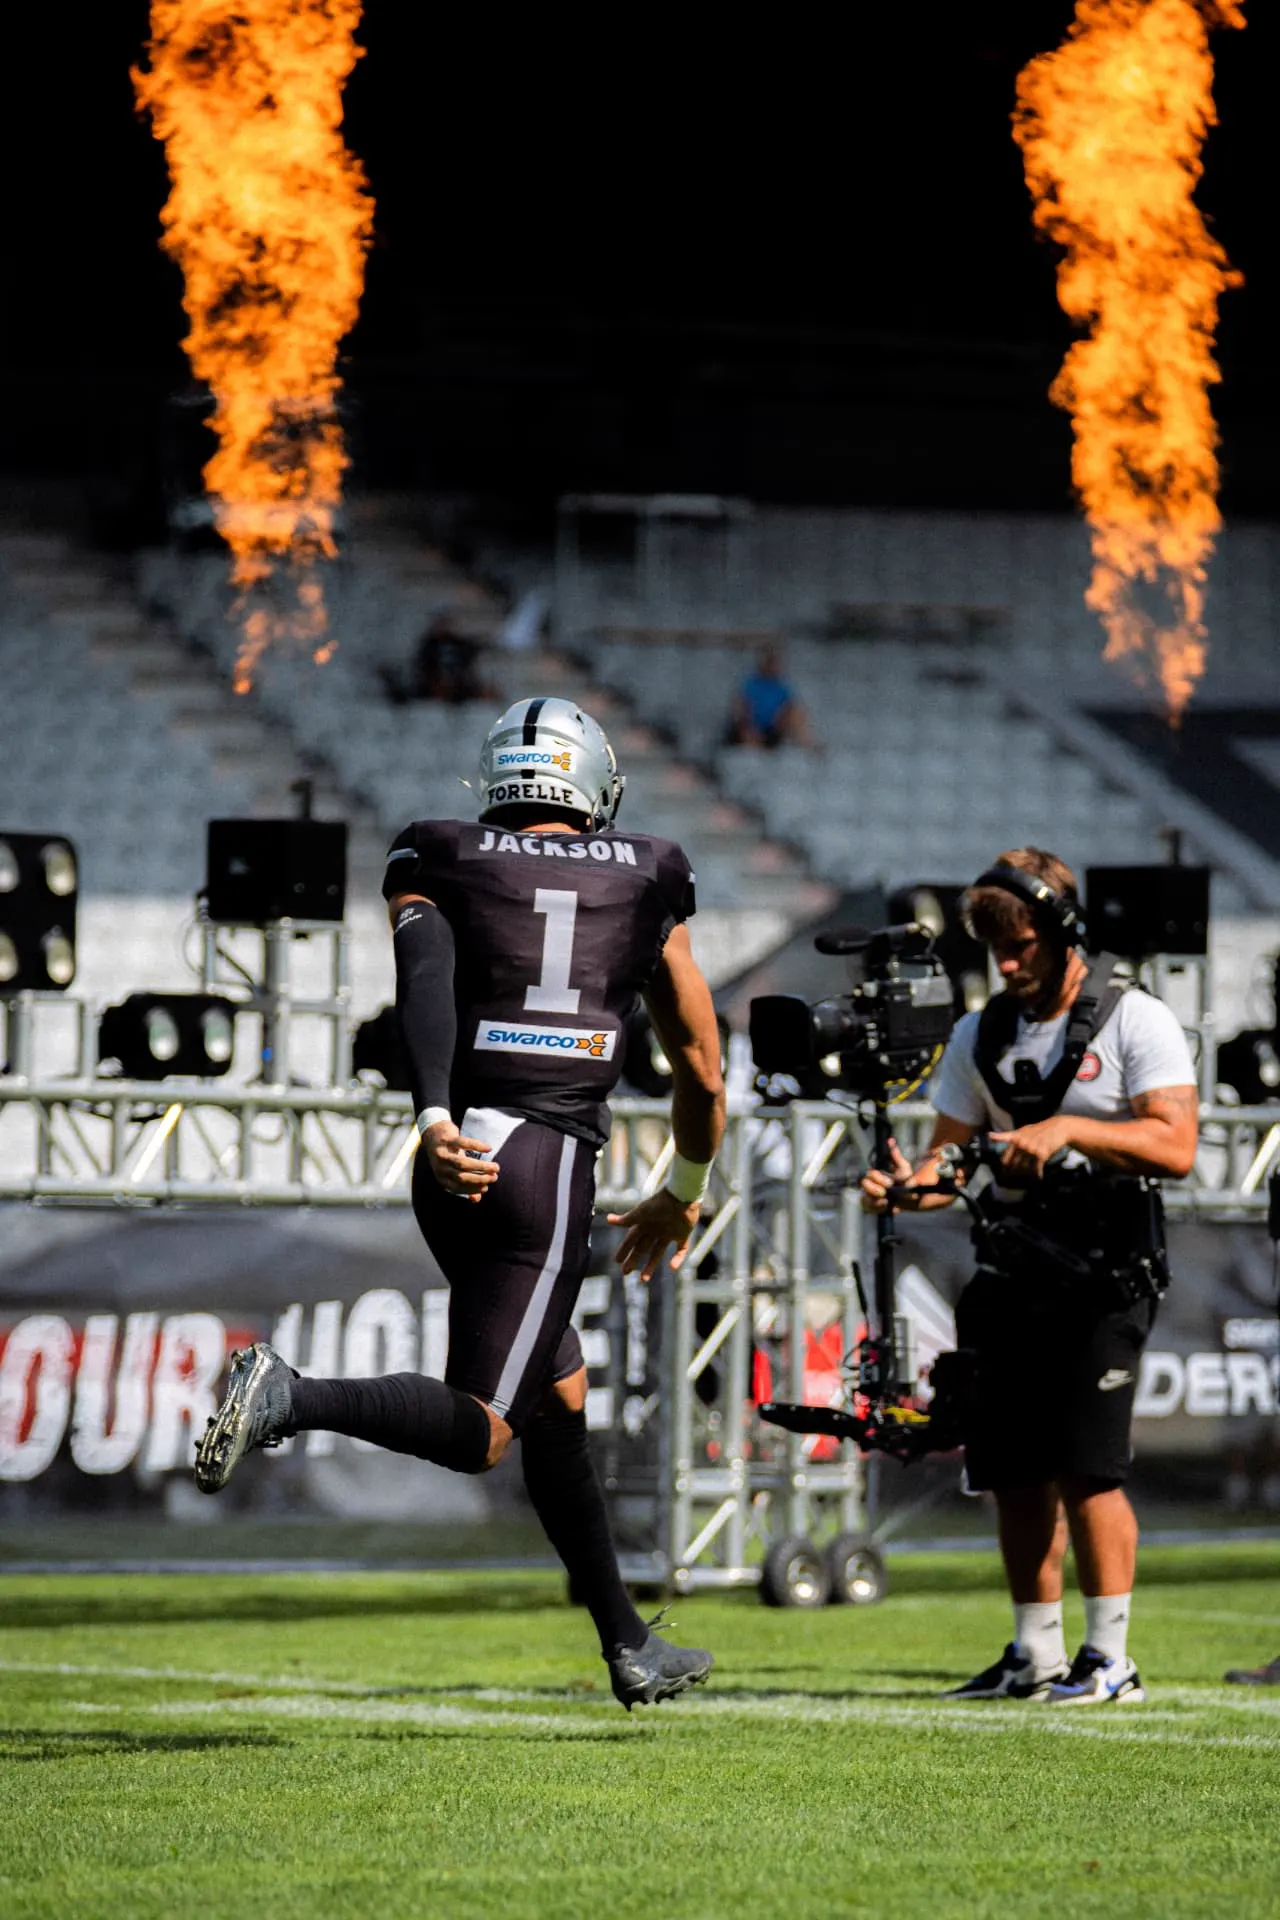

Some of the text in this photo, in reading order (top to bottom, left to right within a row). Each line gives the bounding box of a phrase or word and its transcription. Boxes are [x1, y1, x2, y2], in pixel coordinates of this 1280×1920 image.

[487, 783, 575, 805] FORELLE
[479, 831, 637, 866] JACKSON
[523, 888, 581, 1014] 1
[0, 1313, 226, 1482] OUR
[1132, 1351, 1280, 1416] DER
